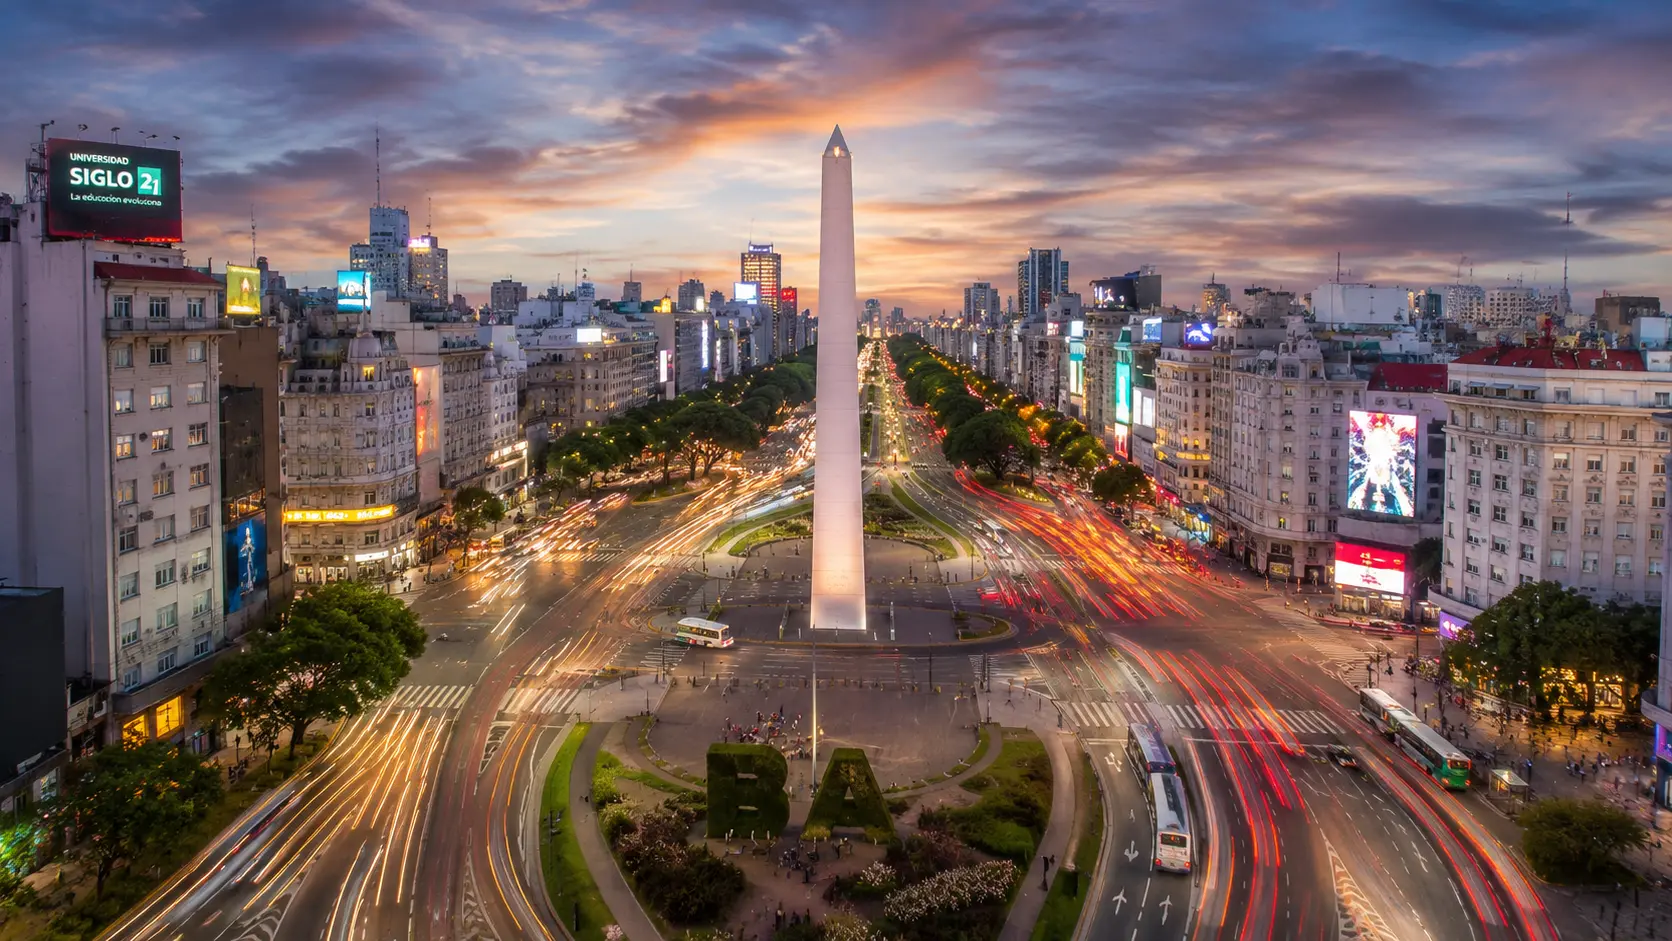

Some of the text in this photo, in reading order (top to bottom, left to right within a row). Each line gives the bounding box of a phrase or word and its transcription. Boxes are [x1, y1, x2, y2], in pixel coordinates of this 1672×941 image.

[69, 153, 129, 165] UNIVERSIDAD
[70, 167, 159, 196] SIGLO 21
[70, 192, 81, 201] La
[706, 743, 897, 844] BA
